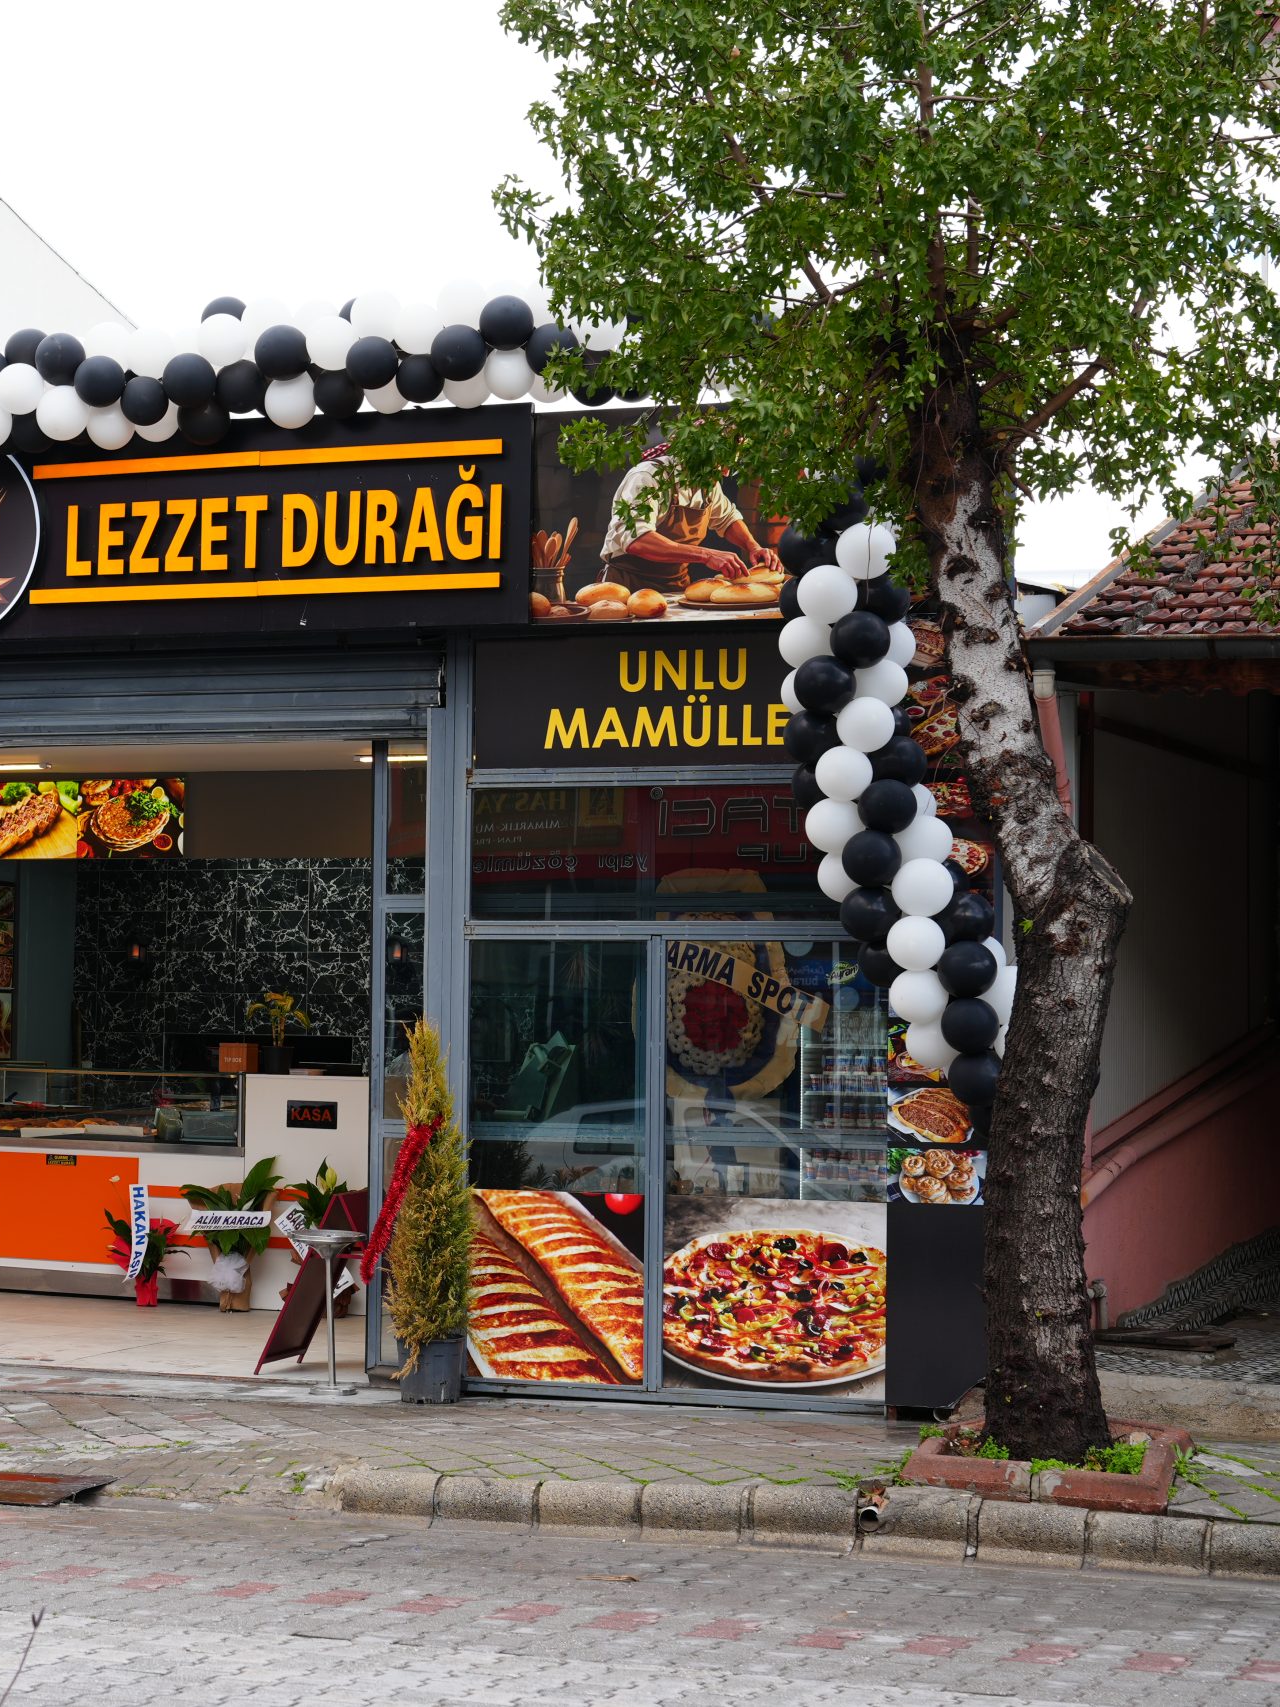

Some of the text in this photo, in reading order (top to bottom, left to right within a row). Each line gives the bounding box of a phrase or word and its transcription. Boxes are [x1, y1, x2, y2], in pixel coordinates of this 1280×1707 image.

[66, 464, 503, 577] LEZZET DURAĞI
[619, 648, 747, 693] UNLU
[544, 695, 789, 749] MAMÜLLE
[747, 972, 813, 1021] SPOT
[291, 1108, 332, 1122] KASA
[133, 1186, 146, 1246] HAKAN
[195, 1212, 264, 1226] ALİM KARACA
